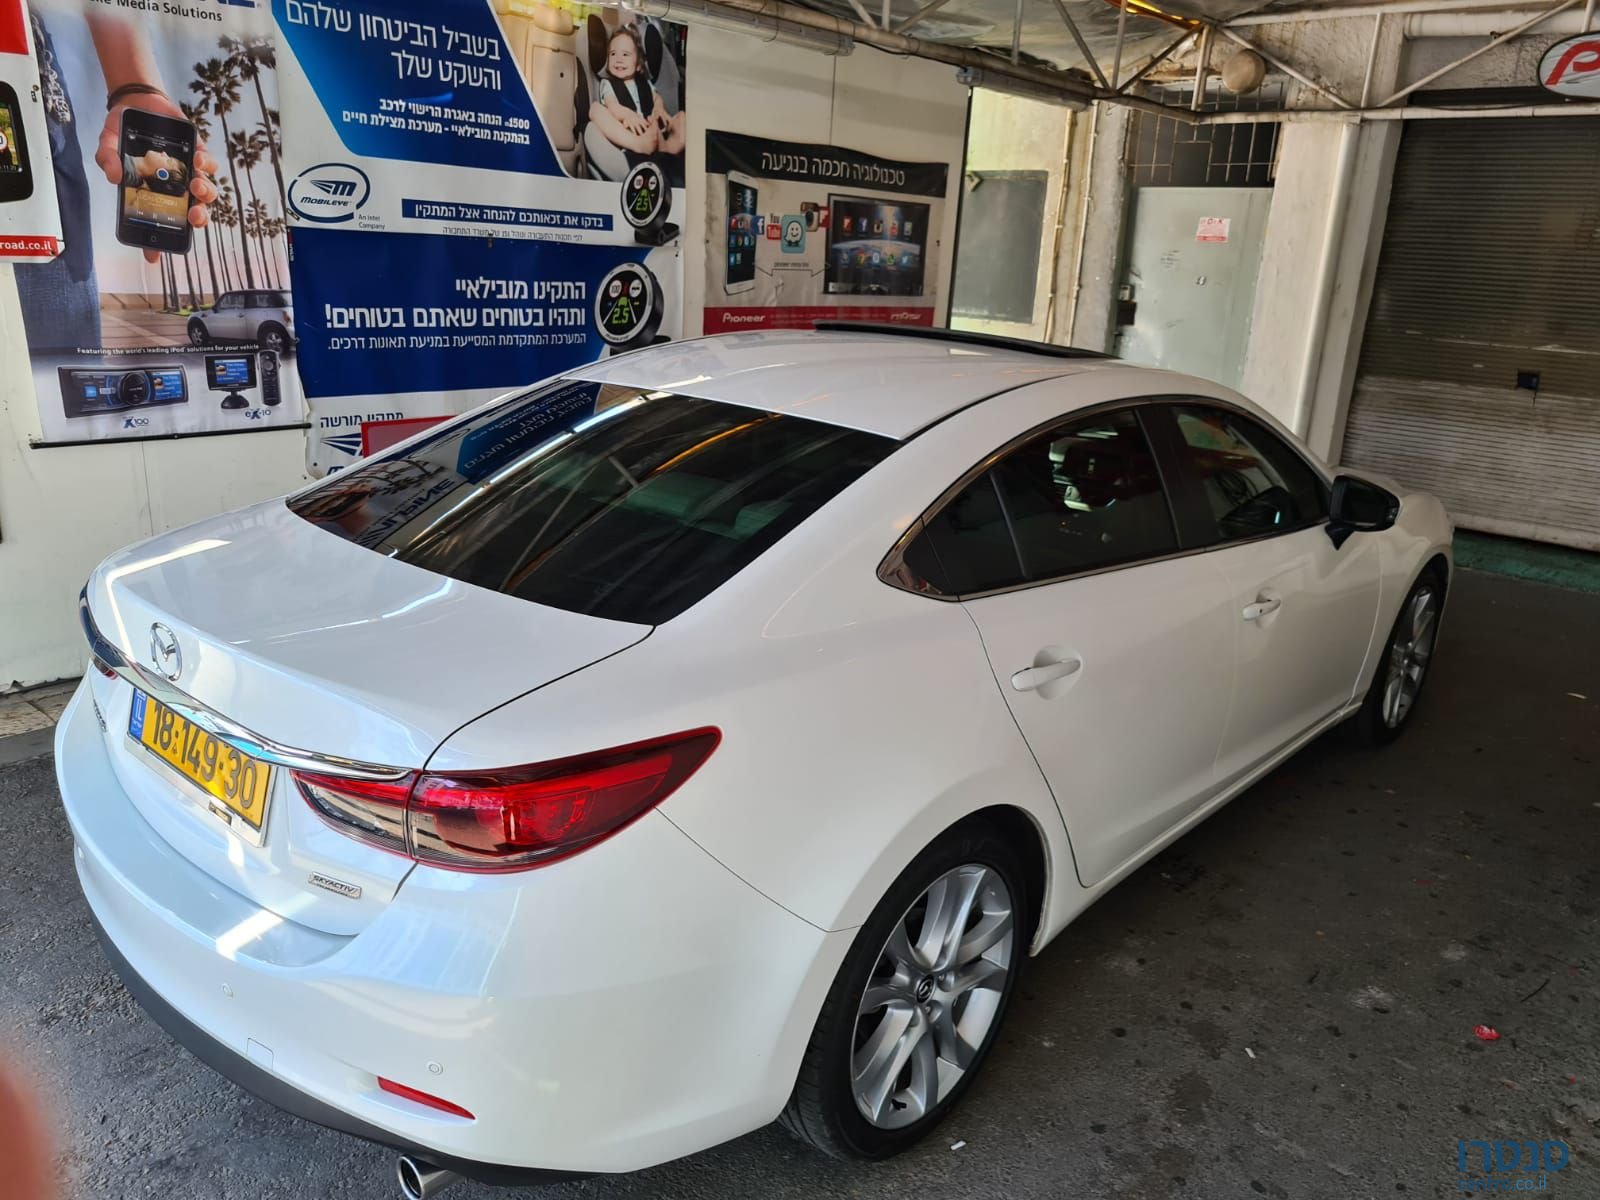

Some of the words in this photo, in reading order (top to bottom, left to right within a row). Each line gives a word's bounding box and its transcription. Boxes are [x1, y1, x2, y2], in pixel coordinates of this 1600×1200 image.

[163, 3, 223, 21] Solutions
[285, 0, 352, 32] שלהם
[360, 13, 437, 48] הביטחון
[442, 25, 501, 60] בשביל
[391, 49, 432, 80] שלך
[439, 60, 501, 91] והשקט
[379, 98, 407, 113] לרכב
[408, 102, 442, 118] הרישוי
[342, 110, 367, 124] חיים
[370, 112, 406, 129] מצילת
[443, 108, 476, 123] באגרת
[477, 112, 502, 127] הנחה
[408, 118, 443, 134] מערכת
[451, 124, 492, 140] מובילאיי
[492, 131, 530, 145] בהתקנת
[761, 152, 808, 174] בנגיעה
[812, 158, 850, 179] חכמה
[852, 163, 905, 186] טכנולוגיה
[415, 203, 456, 218] המתקין
[459, 205, 481, 219] אצל
[483, 208, 516, 222] להנחה
[518, 212, 561, 226] זכאותכם
[563, 214, 580, 226] את
[580, 216, 604, 231] בדקו
[455, 276, 528, 300] מובילאיי
[533, 280, 586, 303] התקינו
[325, 303, 405, 329] בטוחים!
[413, 307, 477, 328] שאתם
[482, 306, 545, 327] בטוחים
[548, 307, 586, 326] ותהיו
[722, 312, 766, 323] Pioneer
[327, 337, 366, 350] דרכים.
[369, 336, 406, 349] תאונות
[410, 335, 450, 348] במניעת
[452, 335, 496, 347] המסייעת
[499, 335, 549, 348] המתקדמת
[551, 333, 587, 345] המערכת
[320, 415, 363, 428] מורשה
[313, 875, 355, 893] SKYACTIV
